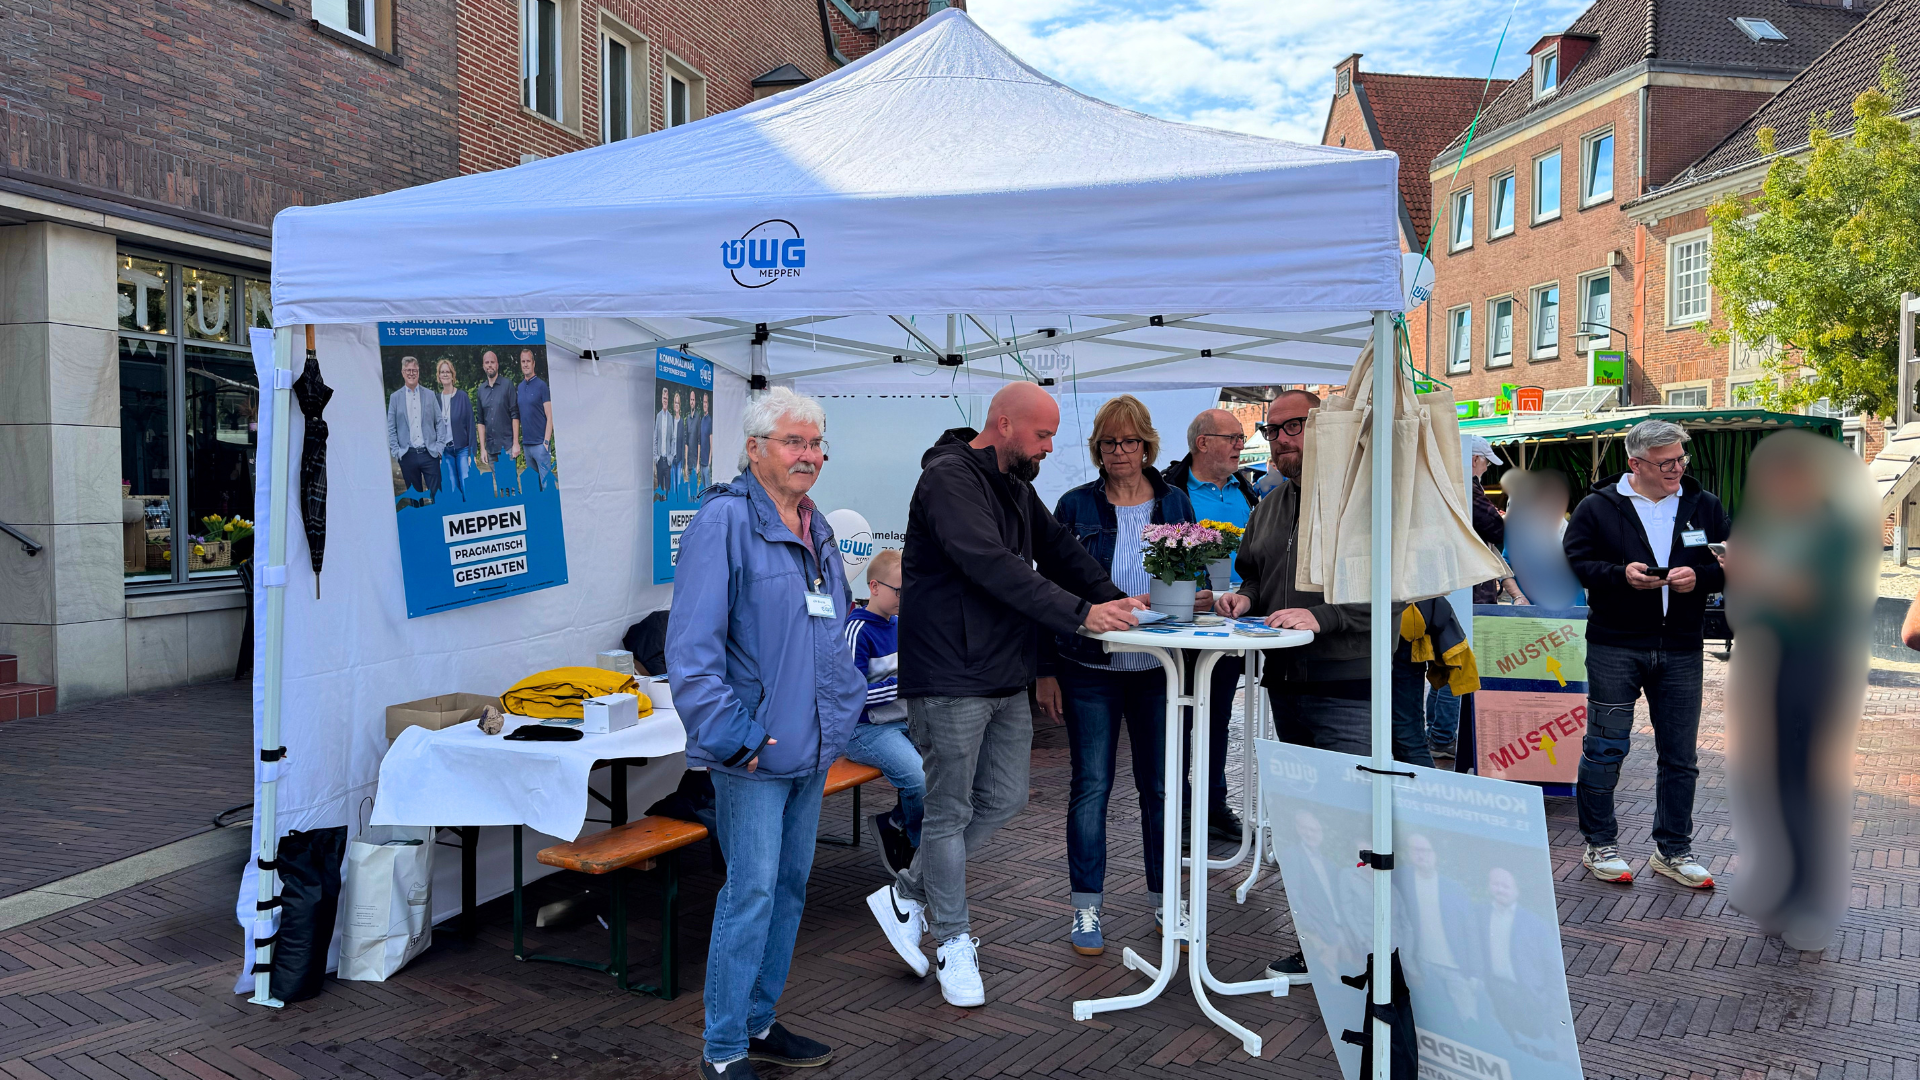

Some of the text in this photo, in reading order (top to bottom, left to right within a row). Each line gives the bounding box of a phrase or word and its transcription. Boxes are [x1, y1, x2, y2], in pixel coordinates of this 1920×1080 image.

[759, 268, 801, 278] MEPPEN
[387, 327, 468, 336] 13. SEPTEMBER 2026
[659, 353, 696, 371] KOMMUNALWAHL
[1596, 376, 1622, 385] Ebken
[448, 510, 522, 537] MEPPEN
[455, 539, 523, 560] PRAGMATISCH
[456, 559, 525, 583] GESTALTEN
[1495, 624, 1579, 675] MUSTER
[1488, 705, 1588, 772] MUSTER
